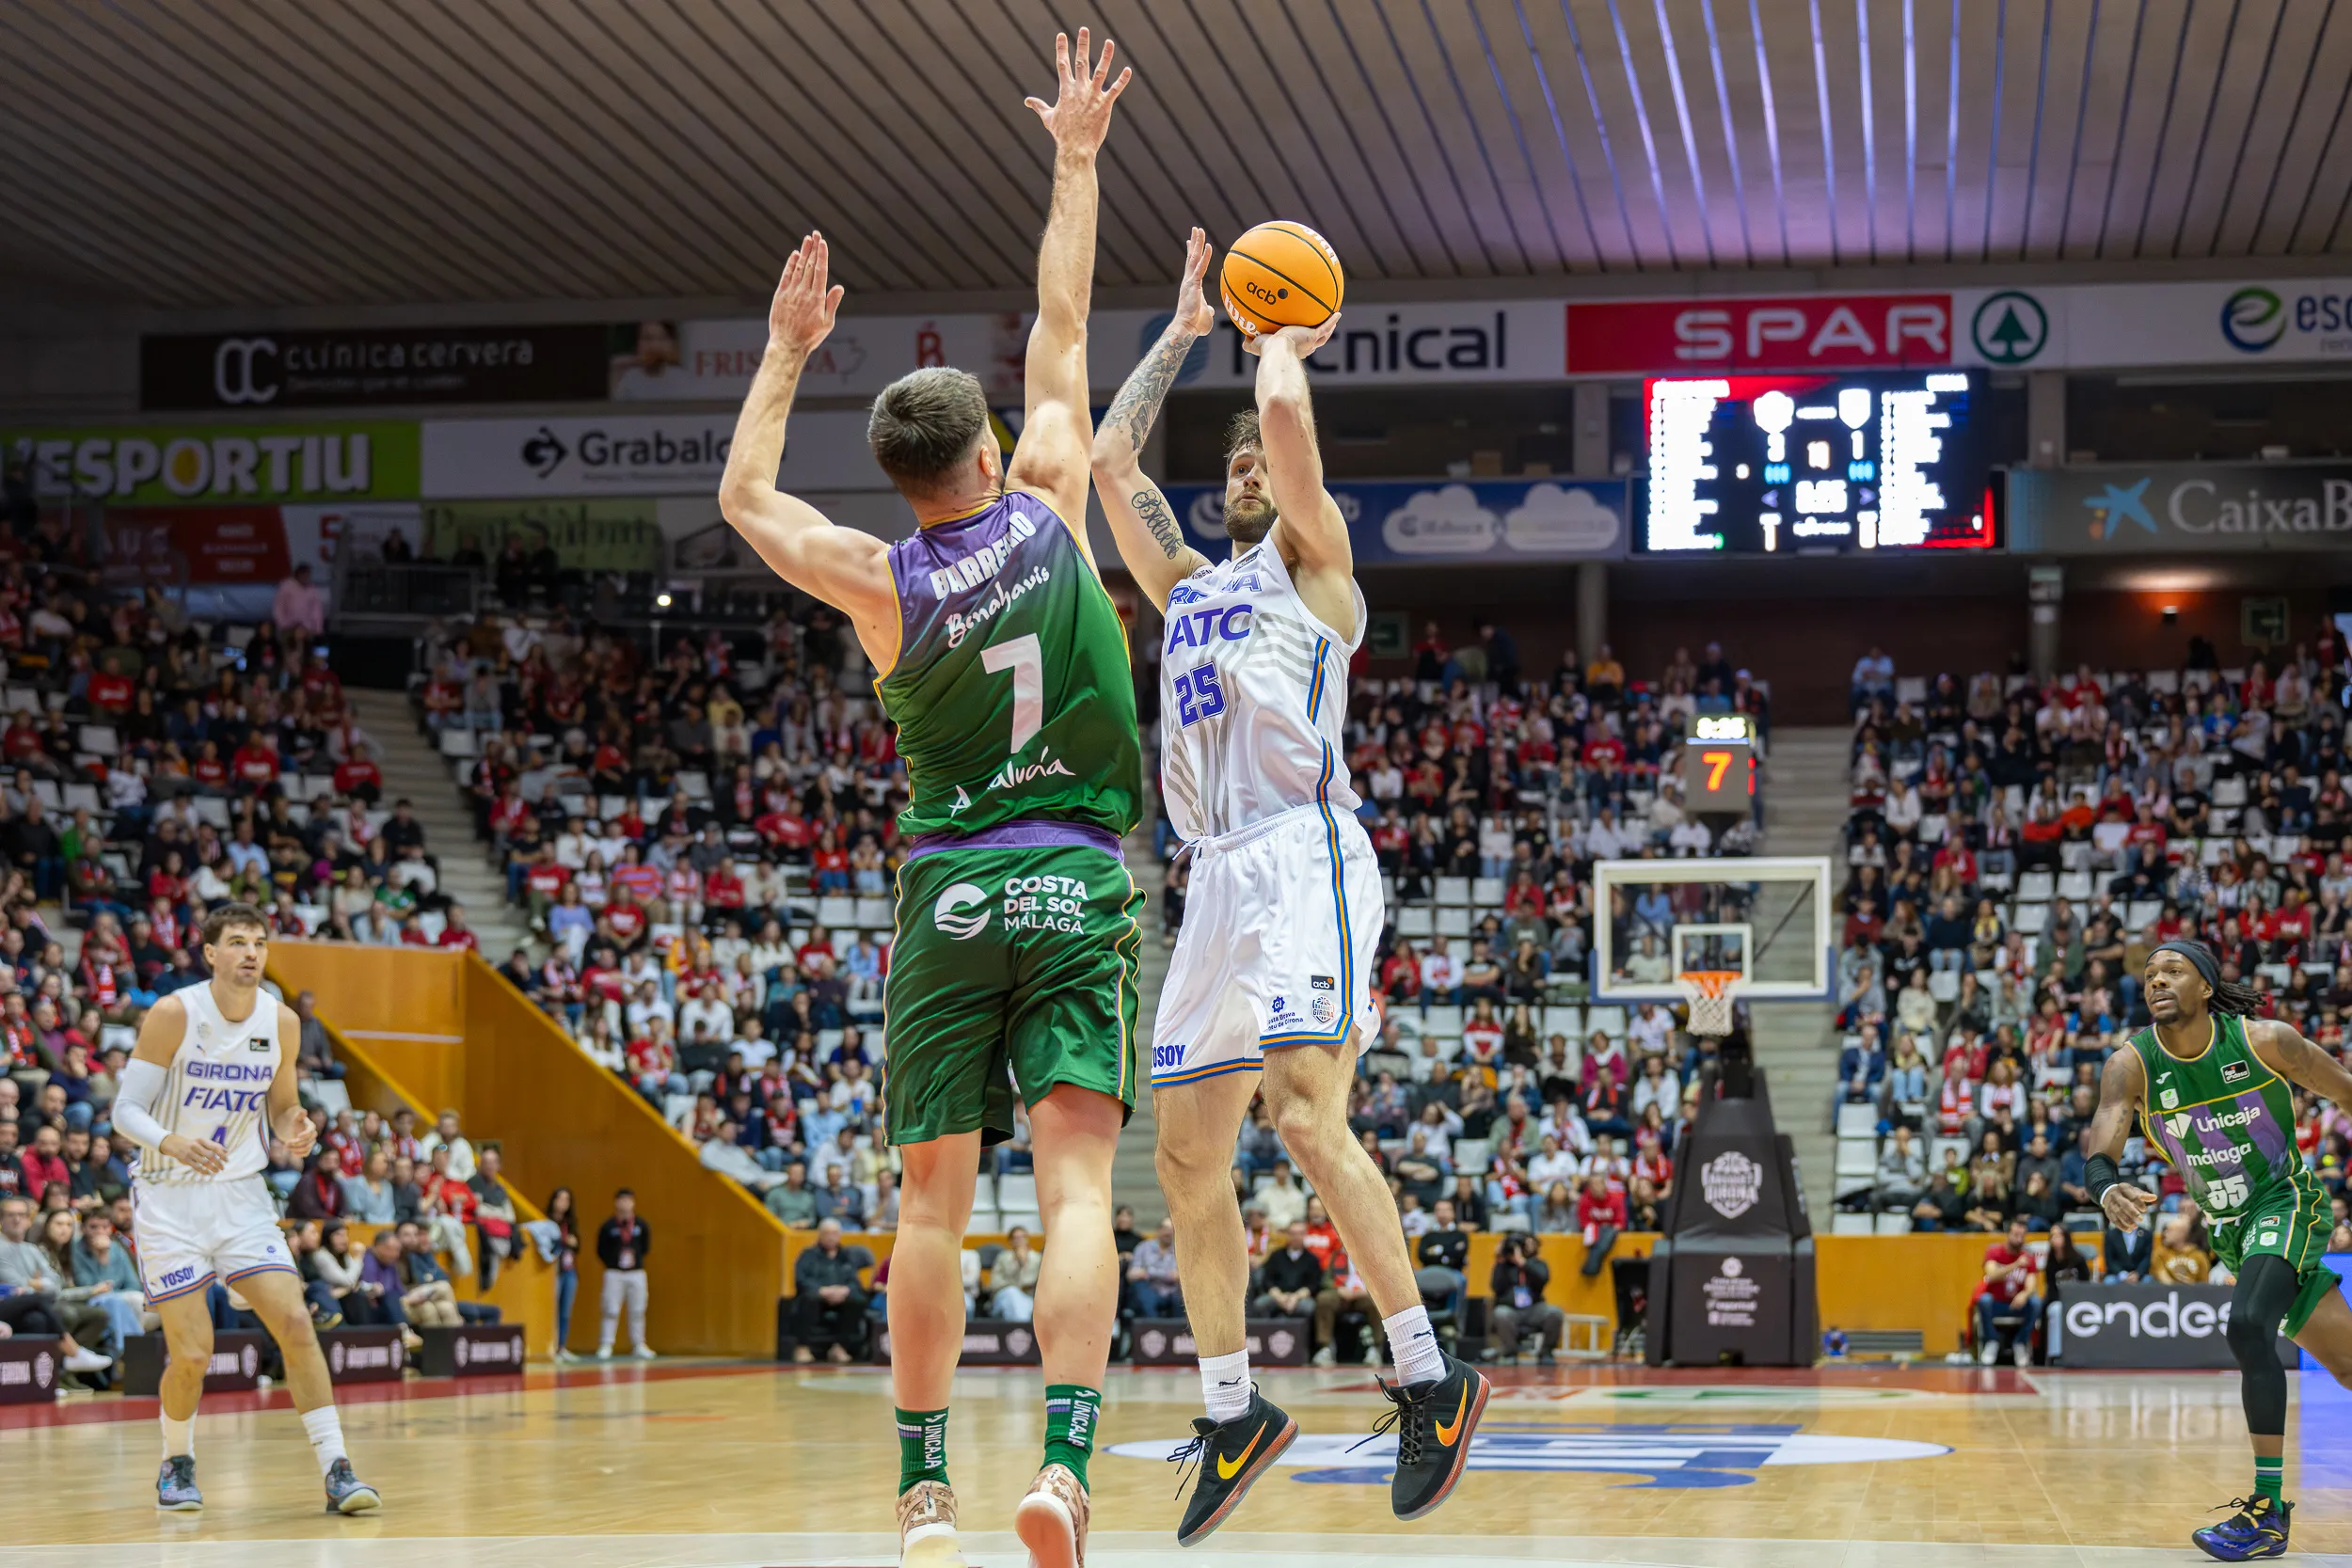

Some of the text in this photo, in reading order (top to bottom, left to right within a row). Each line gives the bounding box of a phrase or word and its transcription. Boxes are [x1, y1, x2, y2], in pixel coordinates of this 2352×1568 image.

[1247, 282, 1277, 305] acb
[1224, 292, 1262, 337] Wil
[1675, 305, 1947, 360] SPAR
[285, 338, 533, 371] clínica cervera
[1219, 312, 1505, 374] Tcnical
[0, 433, 371, 499] 'ESPORTIU
[578, 429, 787, 467] Grabal
[1168, 604, 1253, 656] ATC
[980, 632, 1042, 754] 7
[1174, 662, 1226, 728] 25
[948, 746, 1076, 818] Aalucía
[1702, 751, 1733, 793] 7
[1004, 875, 1089, 901] COSTA
[1003, 896, 1086, 918] DEL SOL
[1004, 911, 1085, 935] MÁLAGA
[1312, 980, 1330, 990] acb
[1279, 1012, 1295, 1021] Brava
[1312, 1008, 1334, 1018] GIRONA
[185, 1060, 274, 1082] GIRONA
[1152, 1045, 1186, 1069] OSOY
[2196, 1106, 2261, 1132] Unicaja
[2206, 1174, 2249, 1210] 55
[160, 1265, 195, 1289] YOSOY
[2066, 1291, 2258, 1338] ende
[1068, 1400, 1093, 1447] UNICAJA
[924, 1423, 943, 1469] UNICAJA
